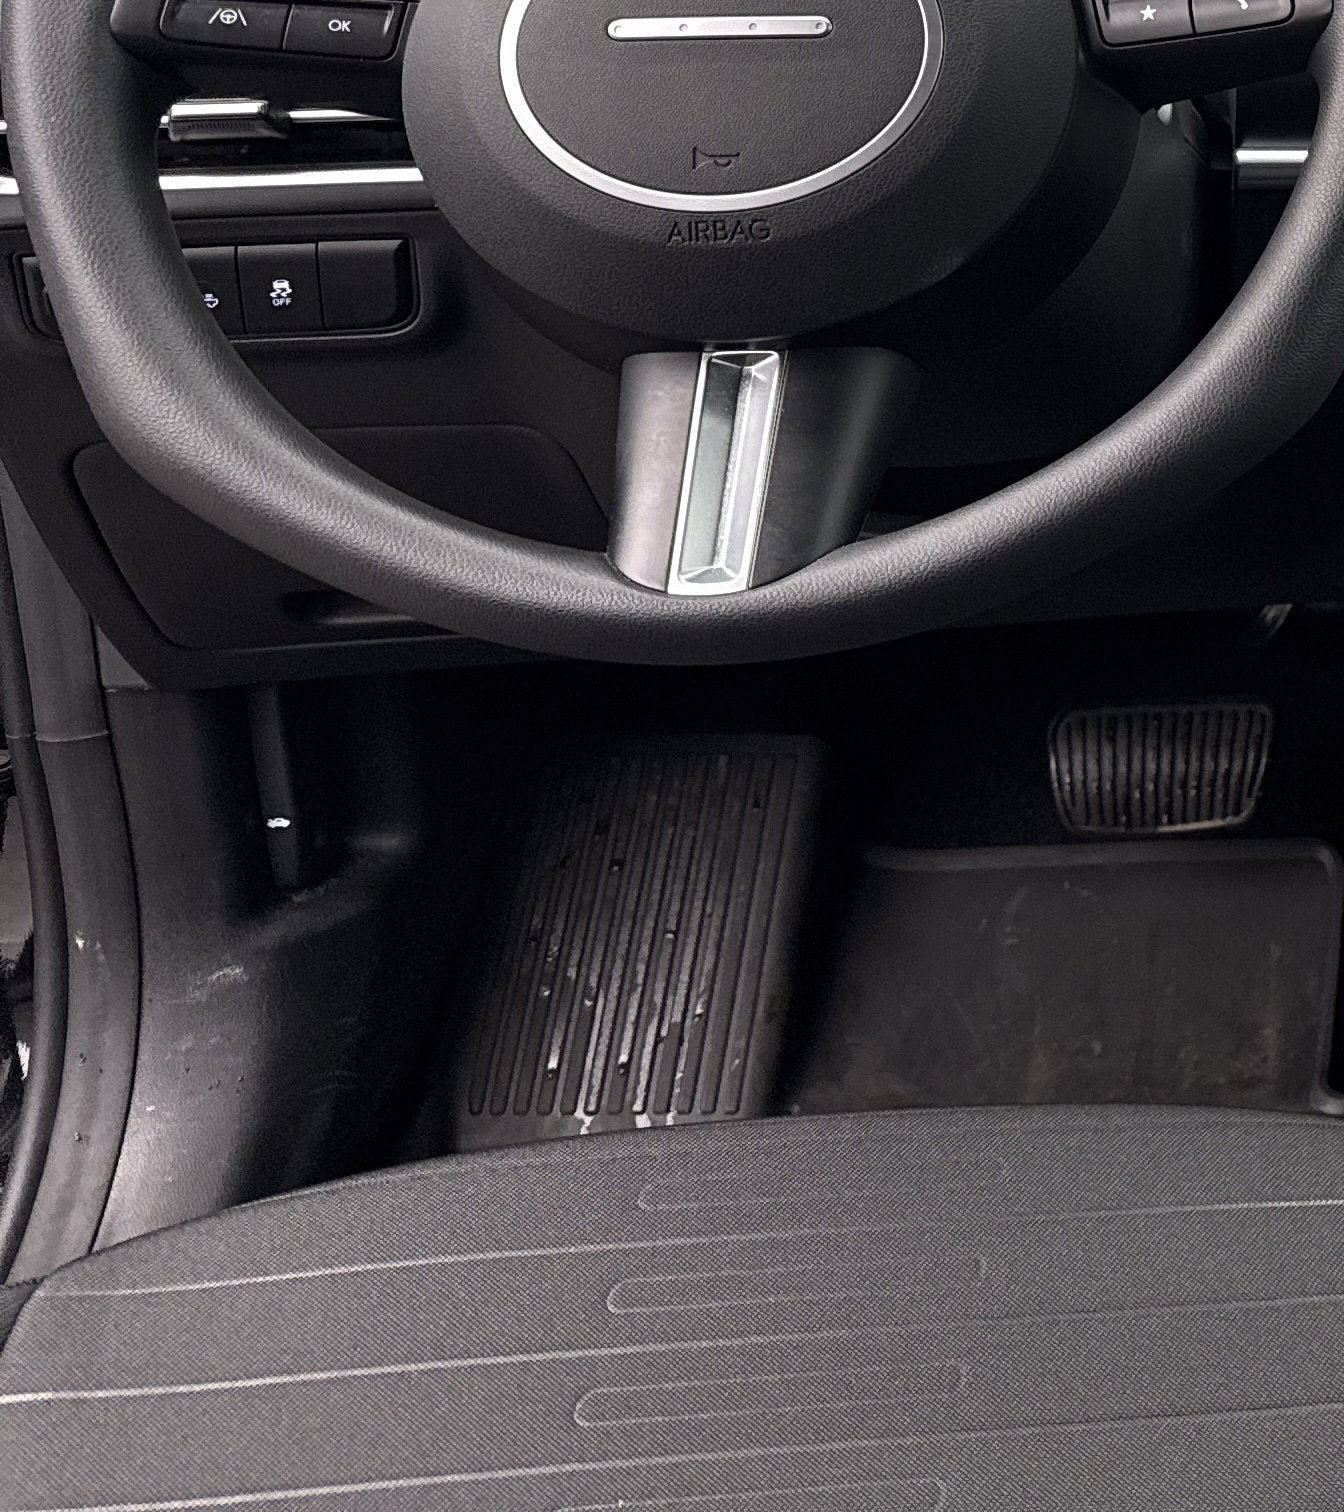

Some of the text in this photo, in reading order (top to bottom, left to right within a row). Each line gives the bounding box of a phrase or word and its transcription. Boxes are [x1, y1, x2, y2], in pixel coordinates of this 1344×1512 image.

[328, 19, 352, 32] OK
[666, 218, 773, 246] AIRBAG
[272, 298, 292, 306] OFF
